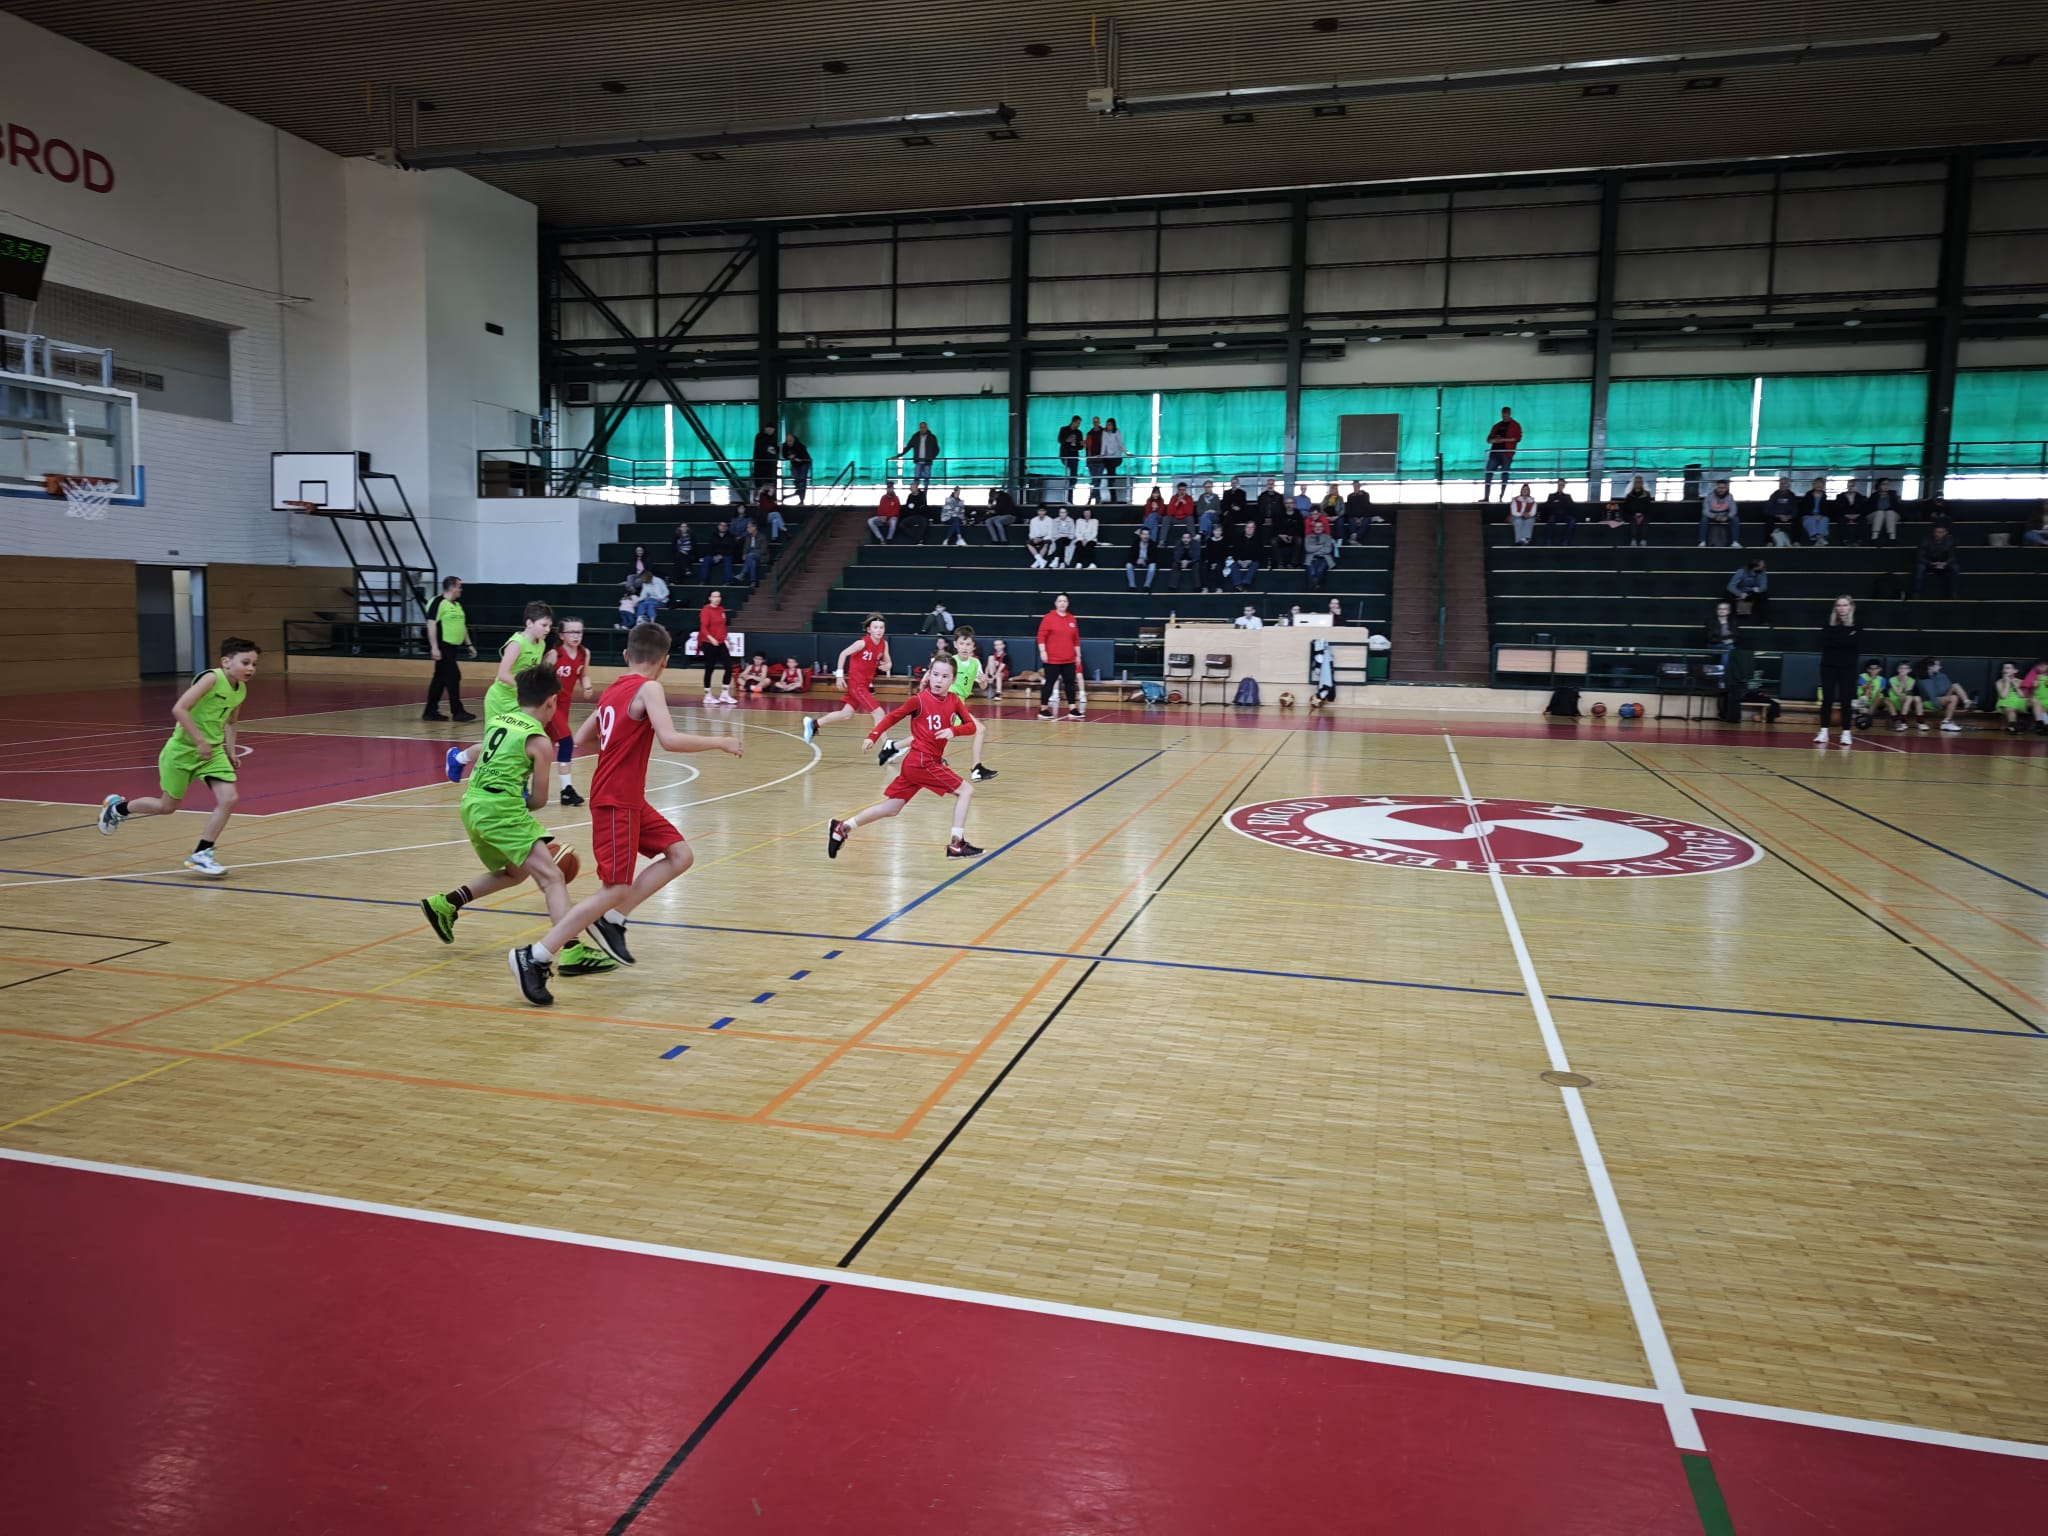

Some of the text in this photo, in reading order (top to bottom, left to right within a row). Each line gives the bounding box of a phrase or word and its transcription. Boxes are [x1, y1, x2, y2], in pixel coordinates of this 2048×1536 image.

[0, 123, 115, 193] ROD
[861, 651, 873, 661] 21
[556, 665, 572, 677] 43
[963, 676, 969, 686] 3
[925, 714, 942, 731] 13
[482, 727, 508, 764] 9
[1247, 801, 1329, 826] BROD
[1576, 830, 1737, 876] SPARTAK
